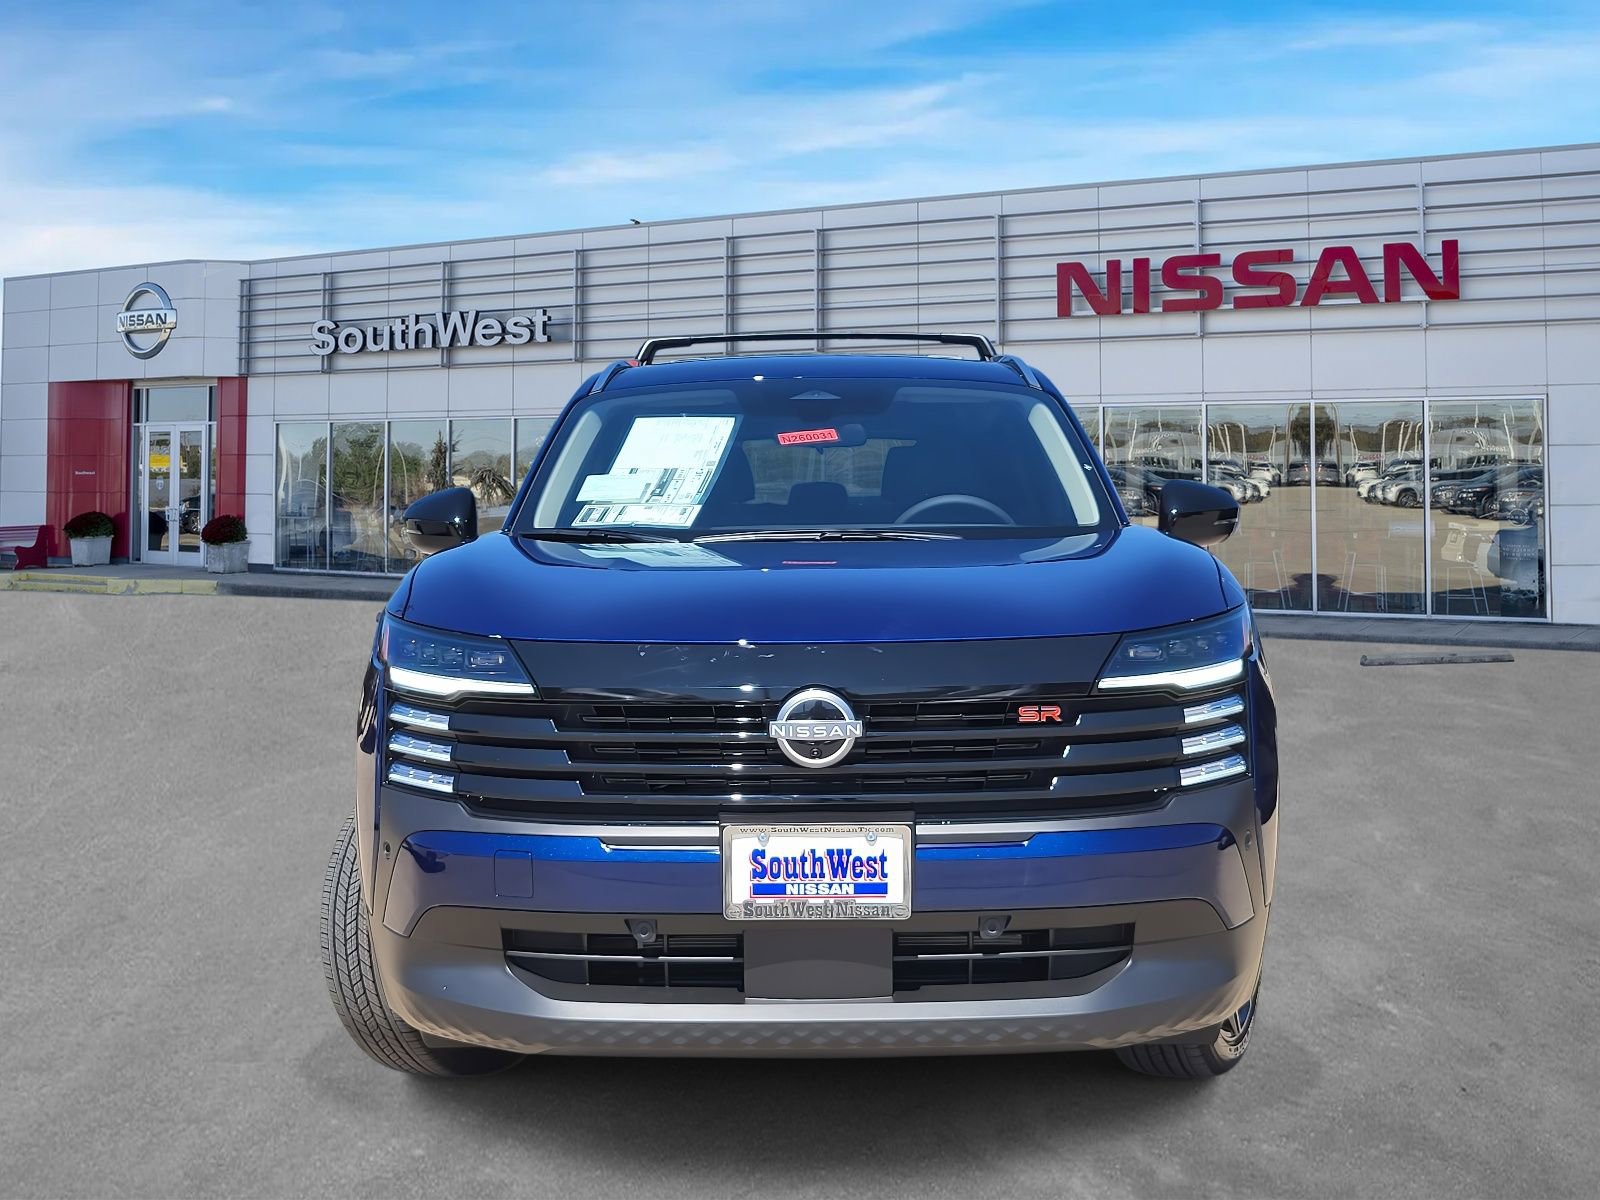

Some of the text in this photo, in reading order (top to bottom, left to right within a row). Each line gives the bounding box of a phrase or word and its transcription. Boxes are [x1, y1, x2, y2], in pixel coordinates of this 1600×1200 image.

[1056, 239, 1460, 318] NISSAN
[119, 312, 168, 328] NISSAN
[309, 308, 551, 356] SouthWest
[781, 431, 834, 444] N260031
[1018, 705, 1063, 723] SR
[771, 723, 862, 738] NISSAN
[785, 883, 855, 895] NISSAN
[836, 901, 891, 918] Nissan
